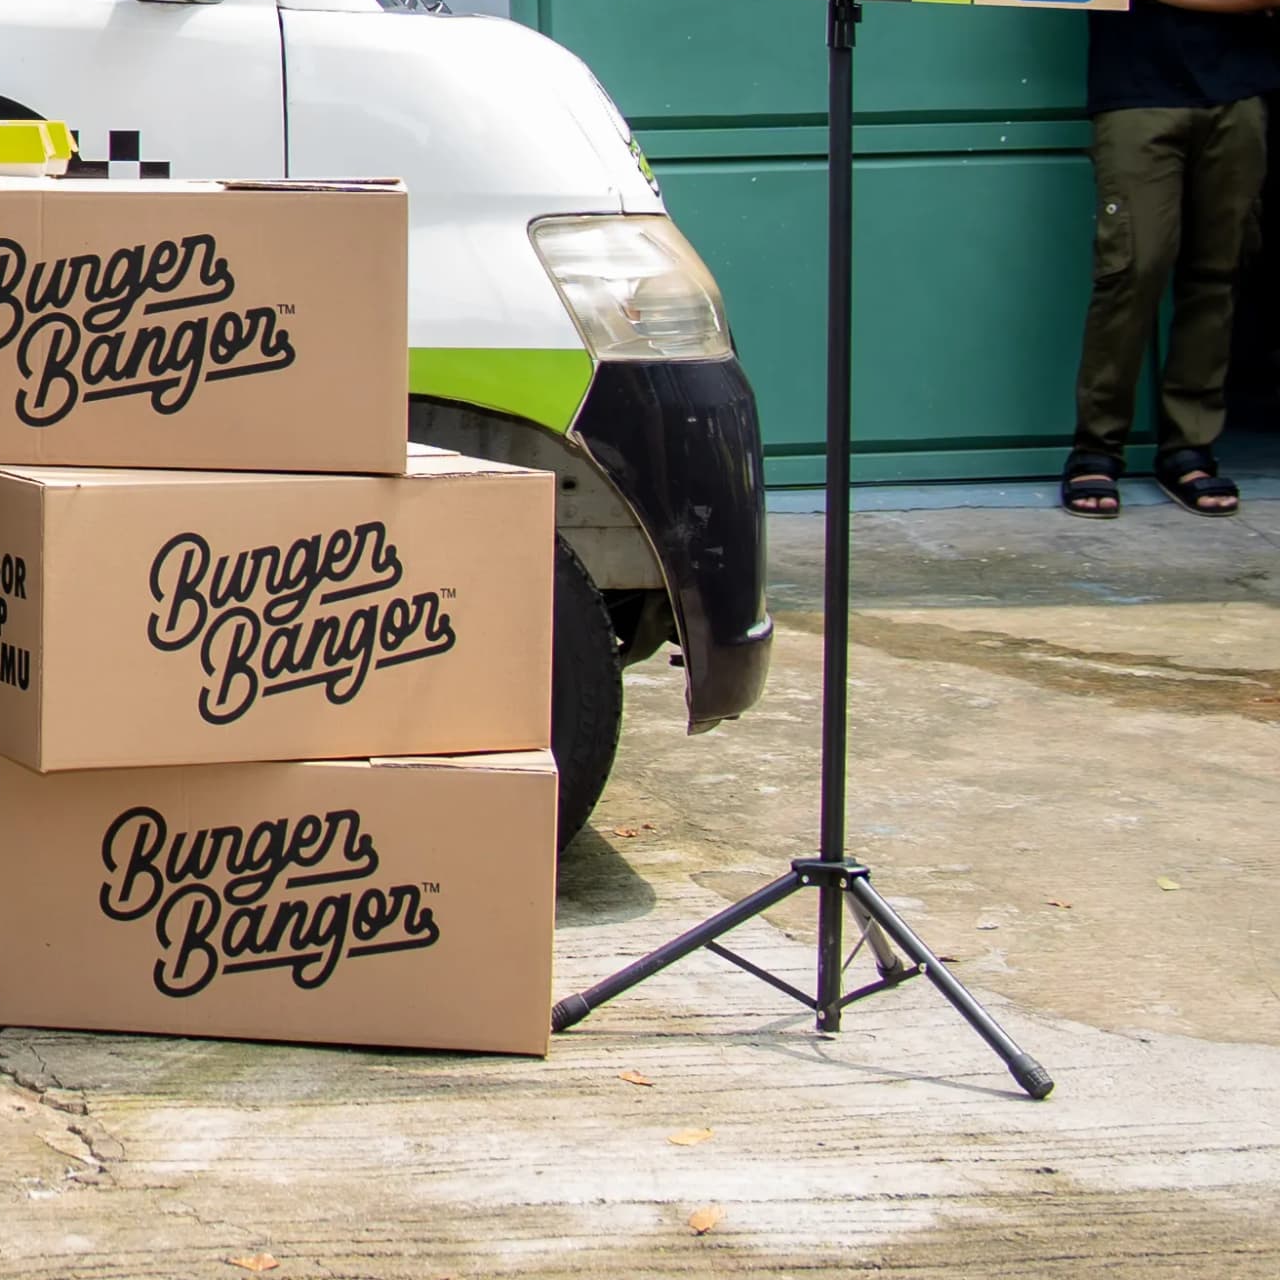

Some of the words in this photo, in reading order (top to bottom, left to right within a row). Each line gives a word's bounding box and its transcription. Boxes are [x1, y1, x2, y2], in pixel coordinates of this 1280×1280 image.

[15, 305, 296, 428] Bangor
[148, 521, 402, 652] Burger
[198, 590, 456, 725] Bangor
[99, 806, 379, 922] Burger
[153, 883, 440, 998] Bangor
